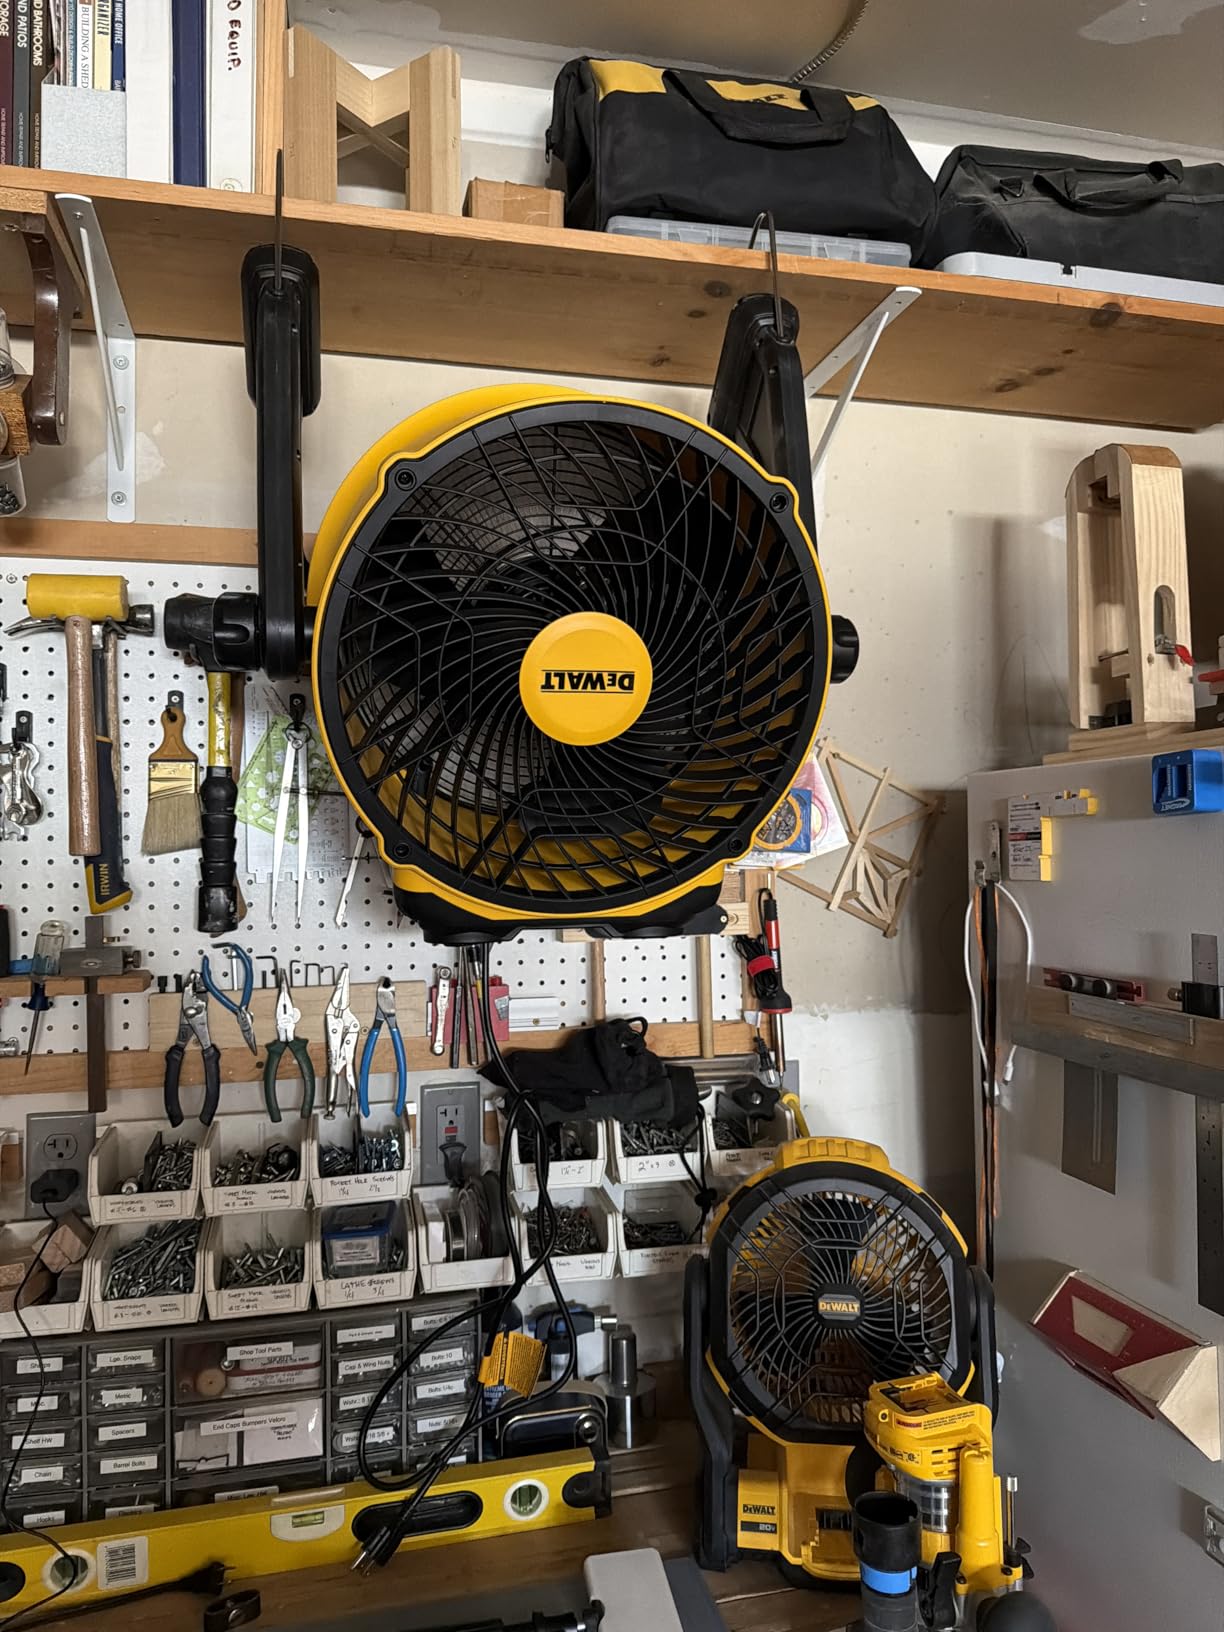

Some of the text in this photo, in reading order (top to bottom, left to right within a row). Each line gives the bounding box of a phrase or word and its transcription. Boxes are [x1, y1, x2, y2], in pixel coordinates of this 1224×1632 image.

[17, 15, 28, 48] PATIOS
[81, 6, 90, 53] BUILDING
[114, 3, 124, 44] HOME OFFICE
[33, 10, 43, 66] BATHROOMS
[227, 19, 242, 71] EQUIP.
[81, 63, 90, 89] SHED
[99, 863, 110, 896] IRWIN
[111, 1428, 136, 1437] Spacers
[212, 1423, 225, 1431] End
[225, 1422, 241, 1430] Caps
[241, 1419, 267, 1427] Bumpers
[41, 1436, 53, 1444] HW
[34, 1471, 52, 1479] Chain
[113, 1460, 147, 1470] Barrel Bolts
[36, 1516, 55, 1524] Hooks
